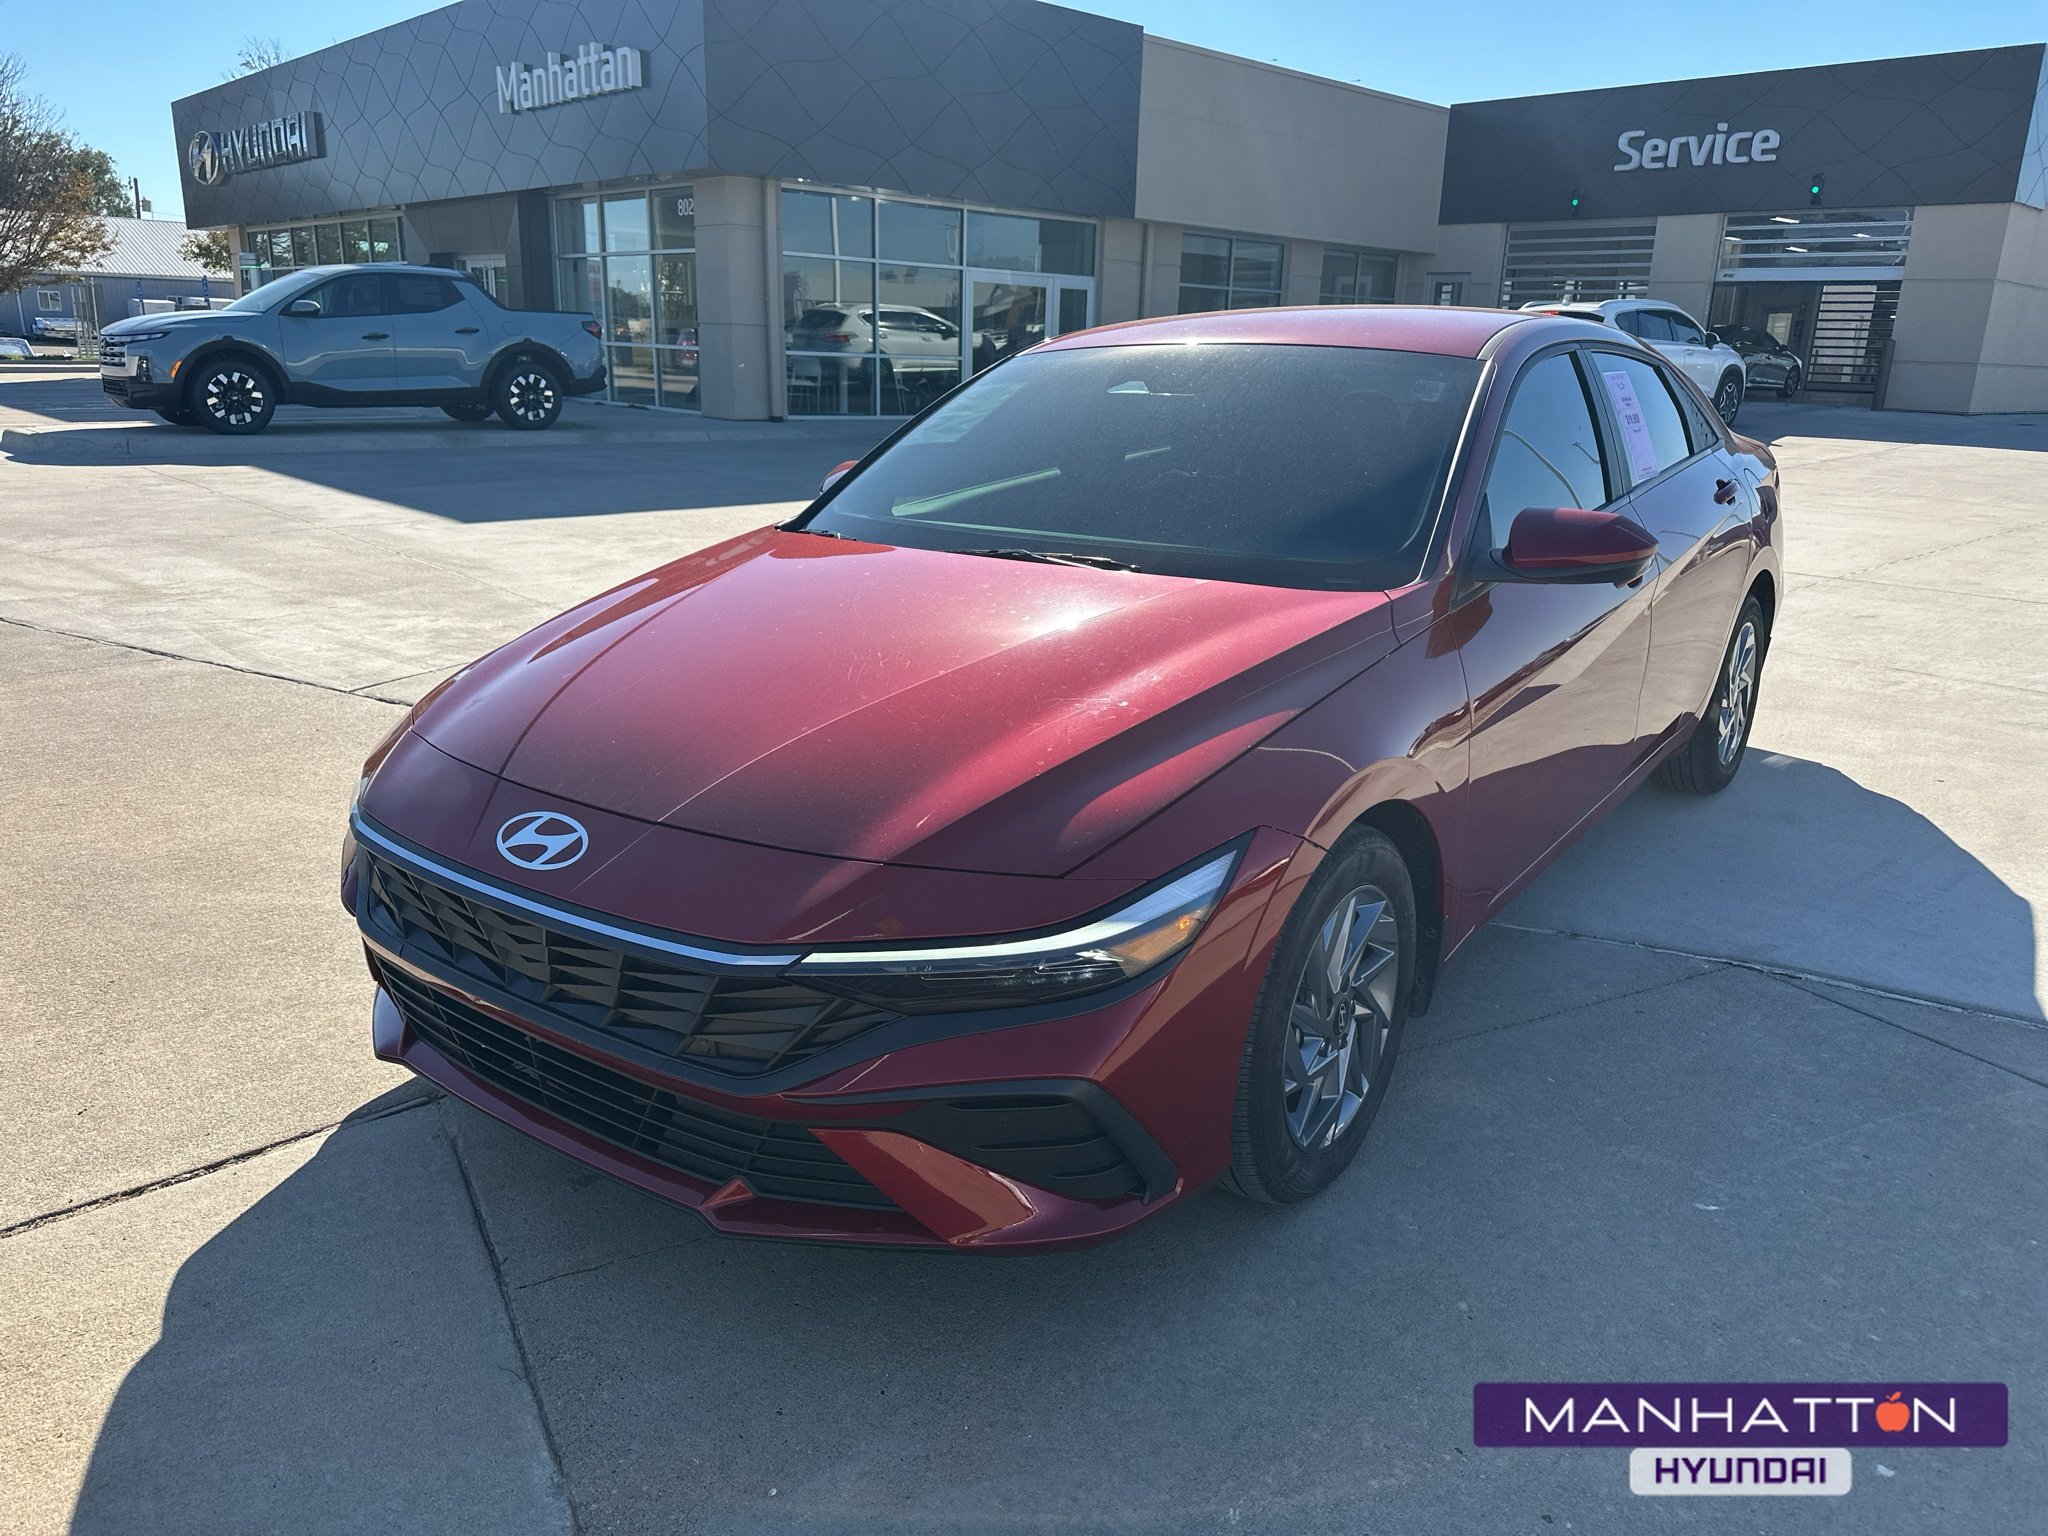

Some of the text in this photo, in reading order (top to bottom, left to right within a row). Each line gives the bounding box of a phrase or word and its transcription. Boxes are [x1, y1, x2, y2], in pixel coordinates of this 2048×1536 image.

[496, 42, 640, 113] Manhattan
[221, 111, 310, 174] HYUNDAI
[1614, 122, 1780, 171] Service
[677, 198, 694, 216] 802
